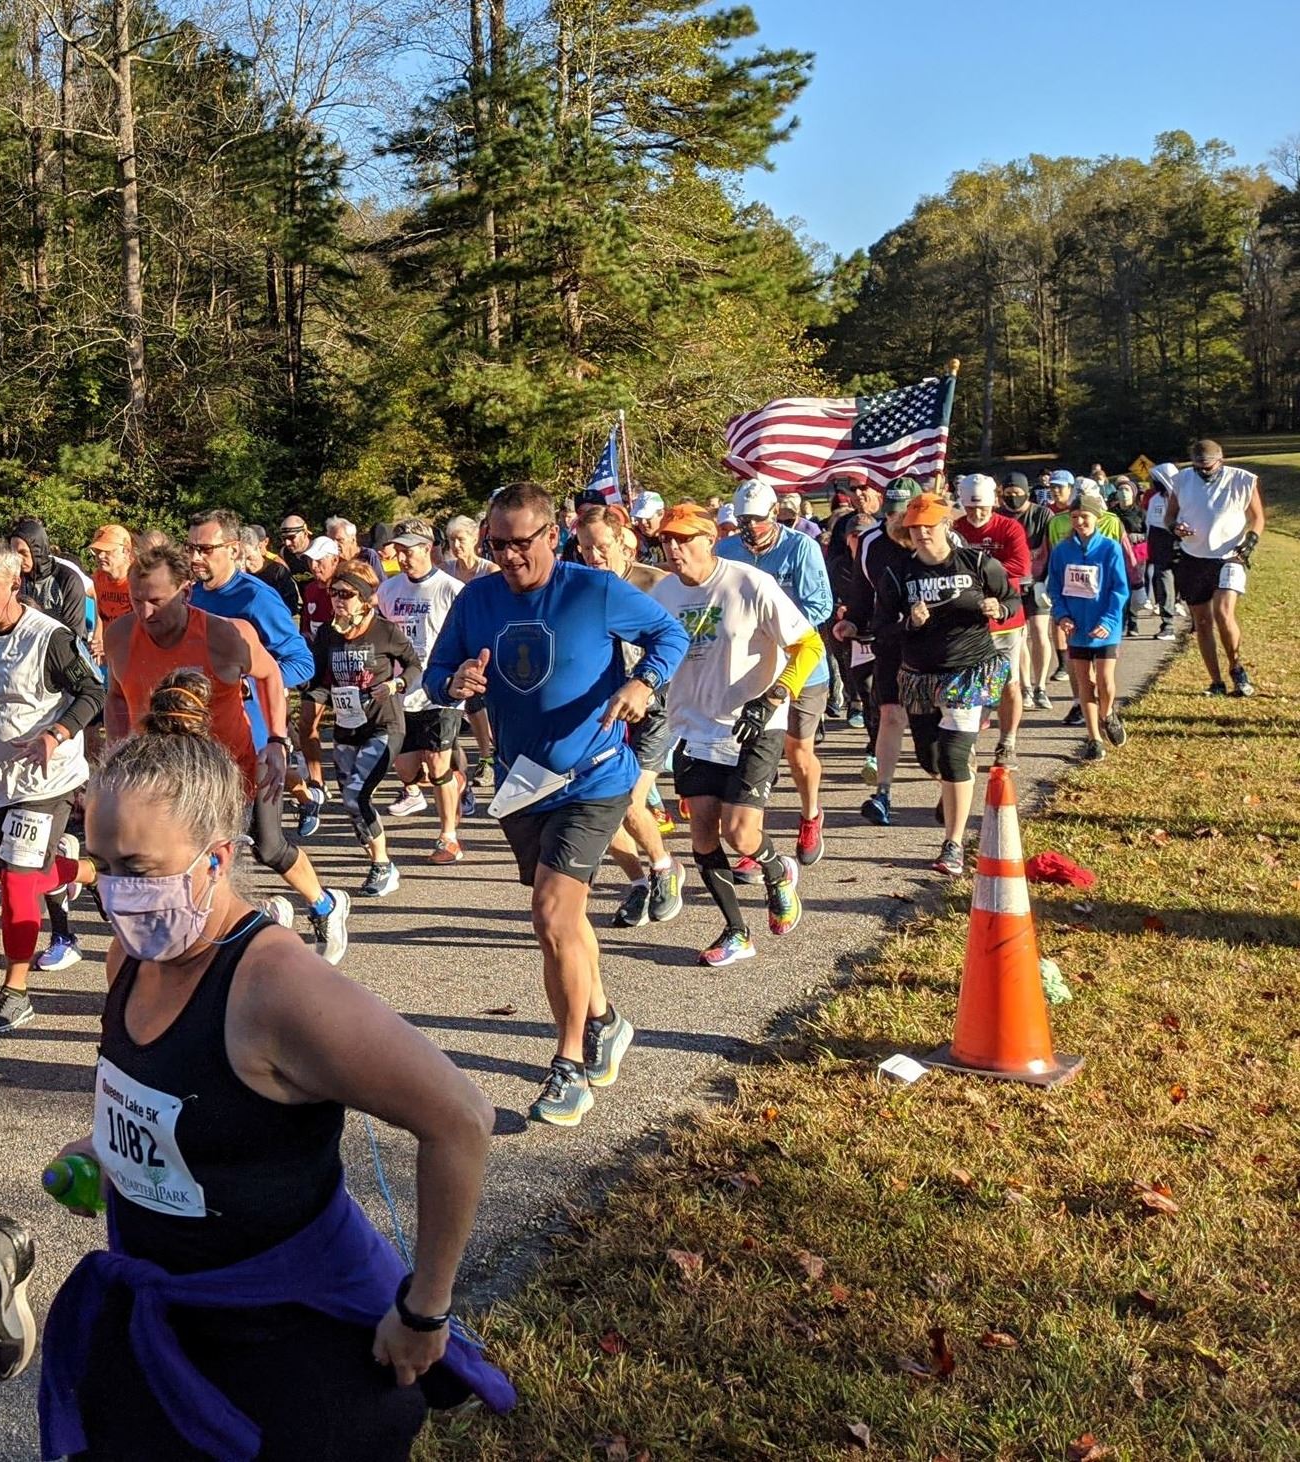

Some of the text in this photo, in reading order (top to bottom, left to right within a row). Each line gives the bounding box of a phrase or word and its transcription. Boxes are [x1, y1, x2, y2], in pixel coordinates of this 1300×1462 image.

[918, 575, 973, 591] WICKED
[919, 589, 941, 602] 10K
[332, 650, 369, 662] RUN FAST
[332, 661, 364, 672] RUN FAR
[9, 821, 38, 842] 1078
[102, 1079, 160, 1125] Queens Lake 5K
[107, 1106, 165, 1168] 1082
[115, 1170, 191, 1202] QUARTER PARK
